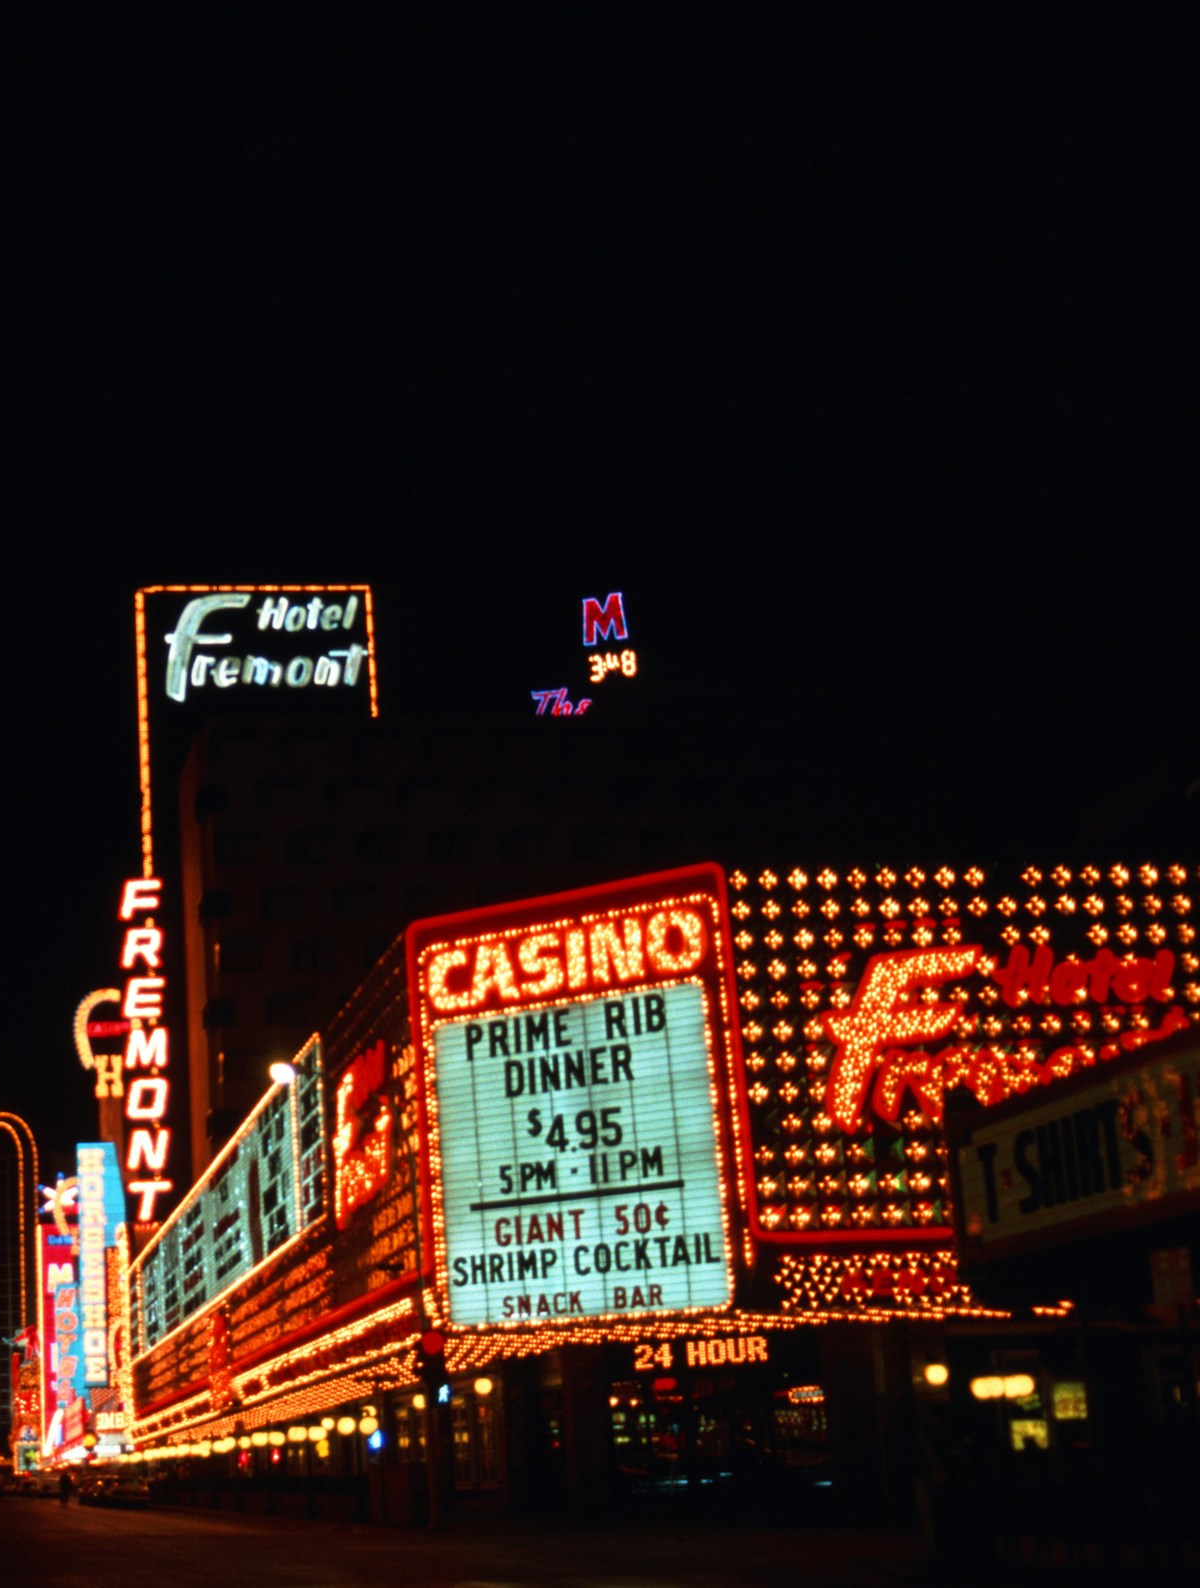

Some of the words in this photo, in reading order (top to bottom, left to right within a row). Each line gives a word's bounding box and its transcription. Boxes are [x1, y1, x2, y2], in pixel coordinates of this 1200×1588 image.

[256, 595, 359, 632] Hotel
[582, 591, 628, 646] M
[164, 593, 369, 703] Fremont
[425, 909, 709, 1014] CASINO
[117, 877, 173, 1223] FREMONT
[464, 1007, 573, 1061] PRIME
[605, 992, 668, 1040] RIB
[504, 1044, 635, 1100] DINNER
[526, 1106, 625, 1153] $4.95
[494, 1208, 586, 1247] GIANT
[613, 1201, 671, 1236] 50¢
[77, 1147, 107, 1383] HORSESHOE
[453, 1247, 558, 1288] SHRIMP
[573, 1231, 722, 1277] COCKTAIL
[502, 1290, 585, 1319] SNACK
[613, 1284, 664, 1309] BAR
[634, 1342, 674, 1370] 24
[686, 1335, 769, 1367] HOUR
